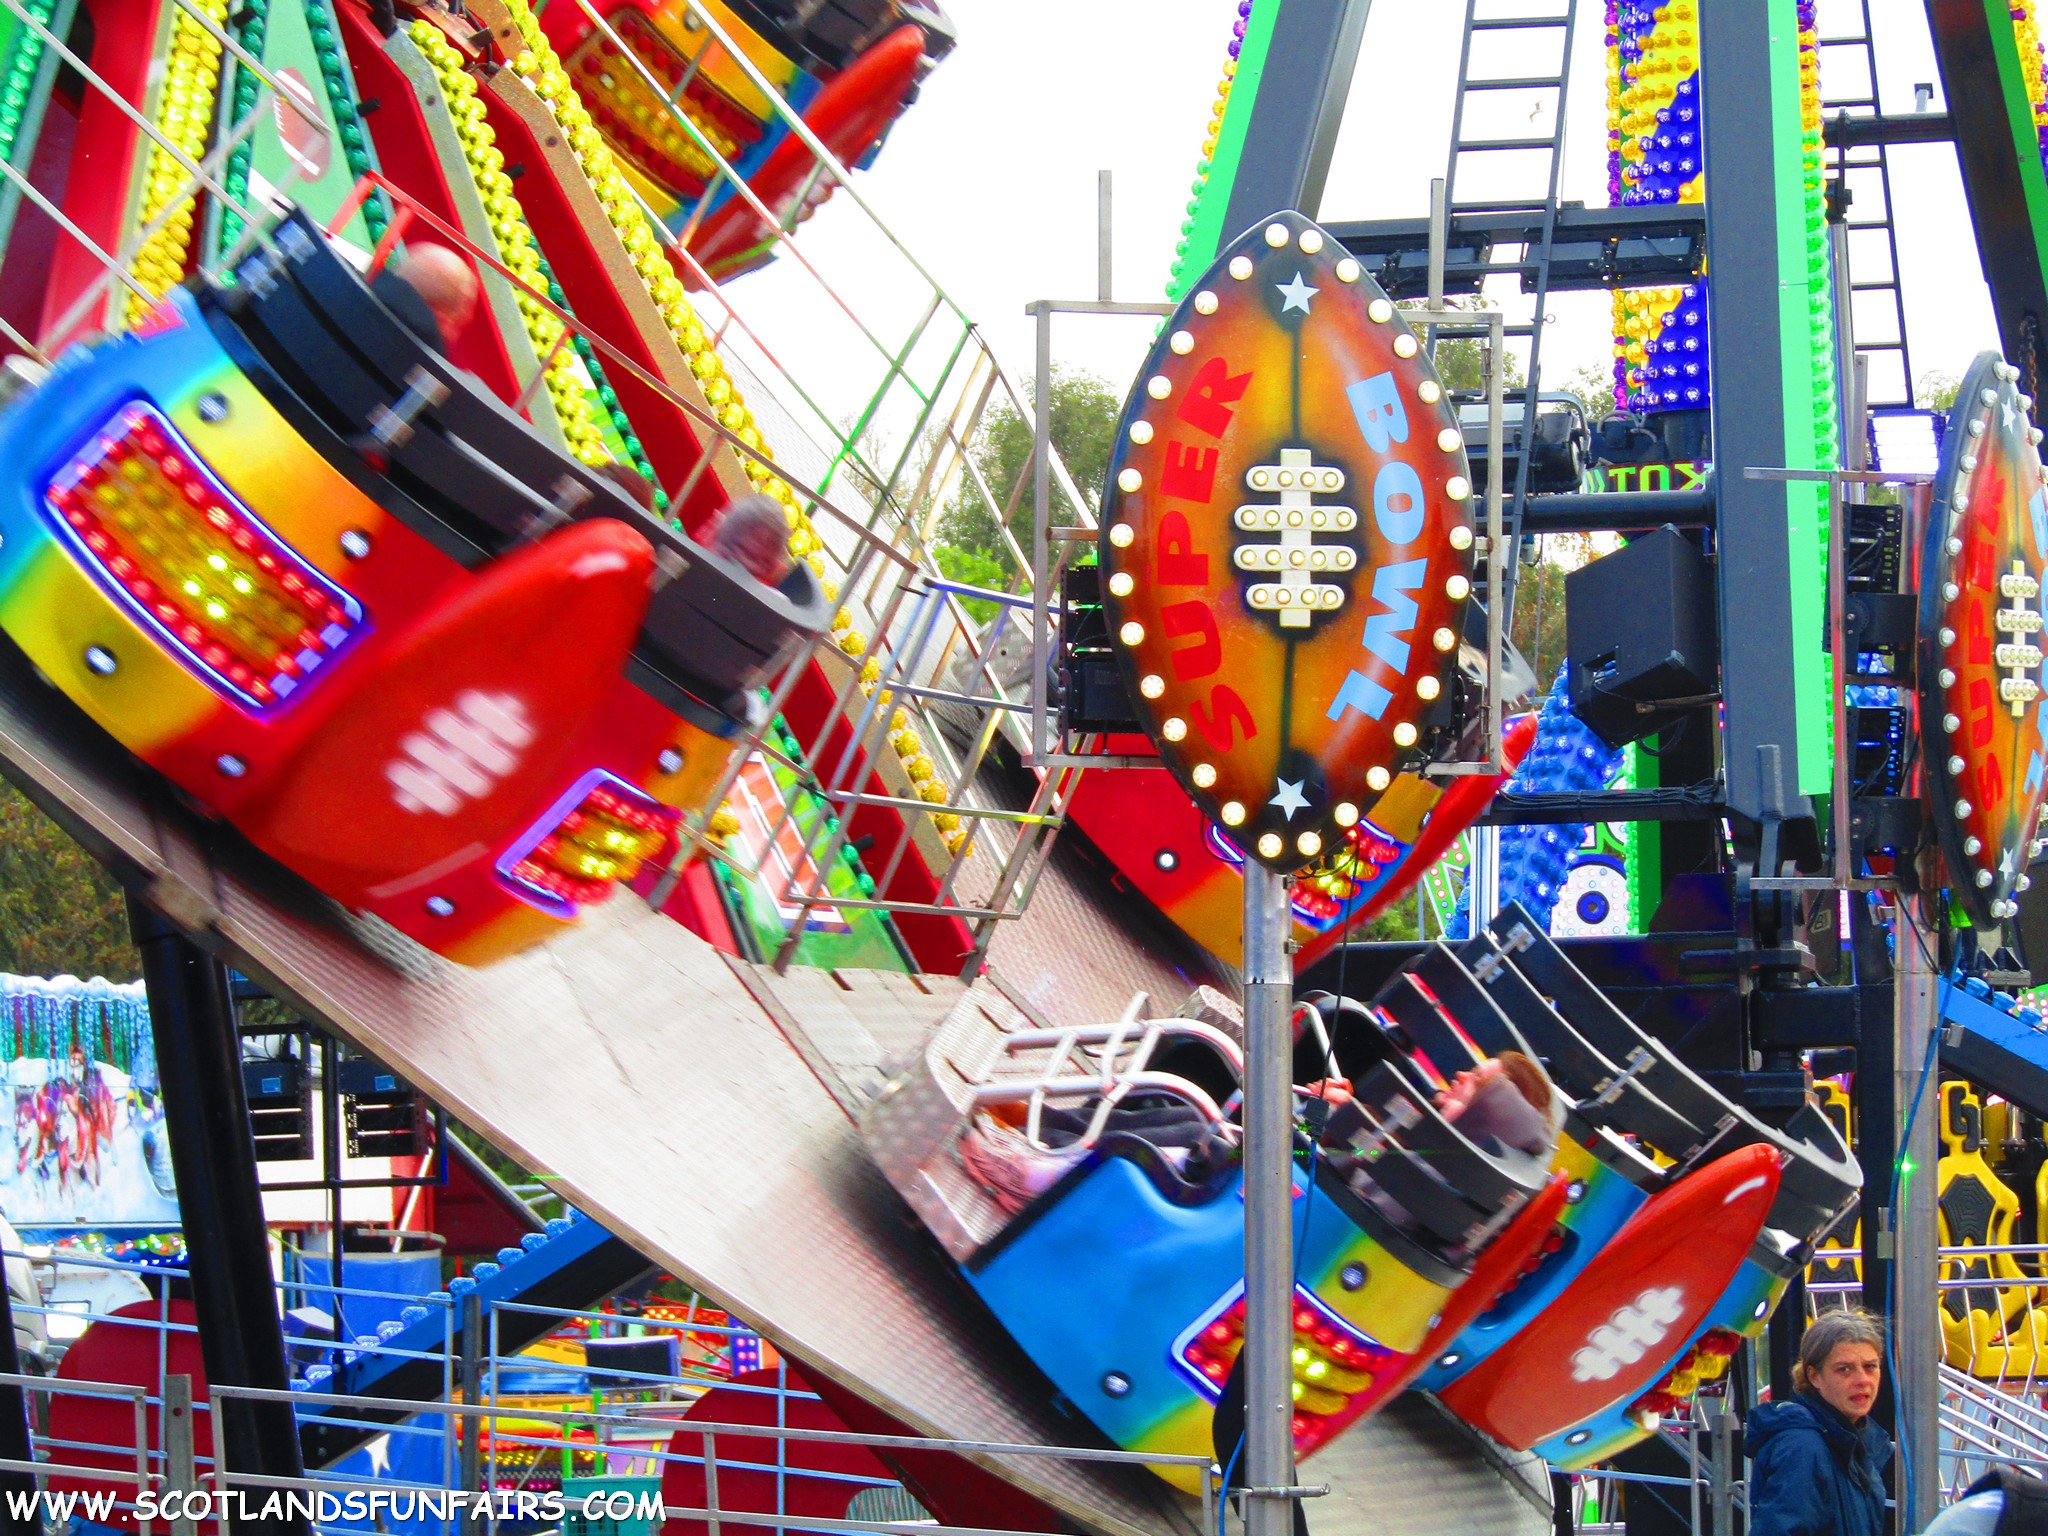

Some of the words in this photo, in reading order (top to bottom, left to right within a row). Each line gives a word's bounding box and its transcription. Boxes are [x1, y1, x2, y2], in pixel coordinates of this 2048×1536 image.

[1158, 356, 1256, 753] SUPER
[1325, 370, 1428, 723] BOWL
[1968, 463, 2006, 812] SUPER
